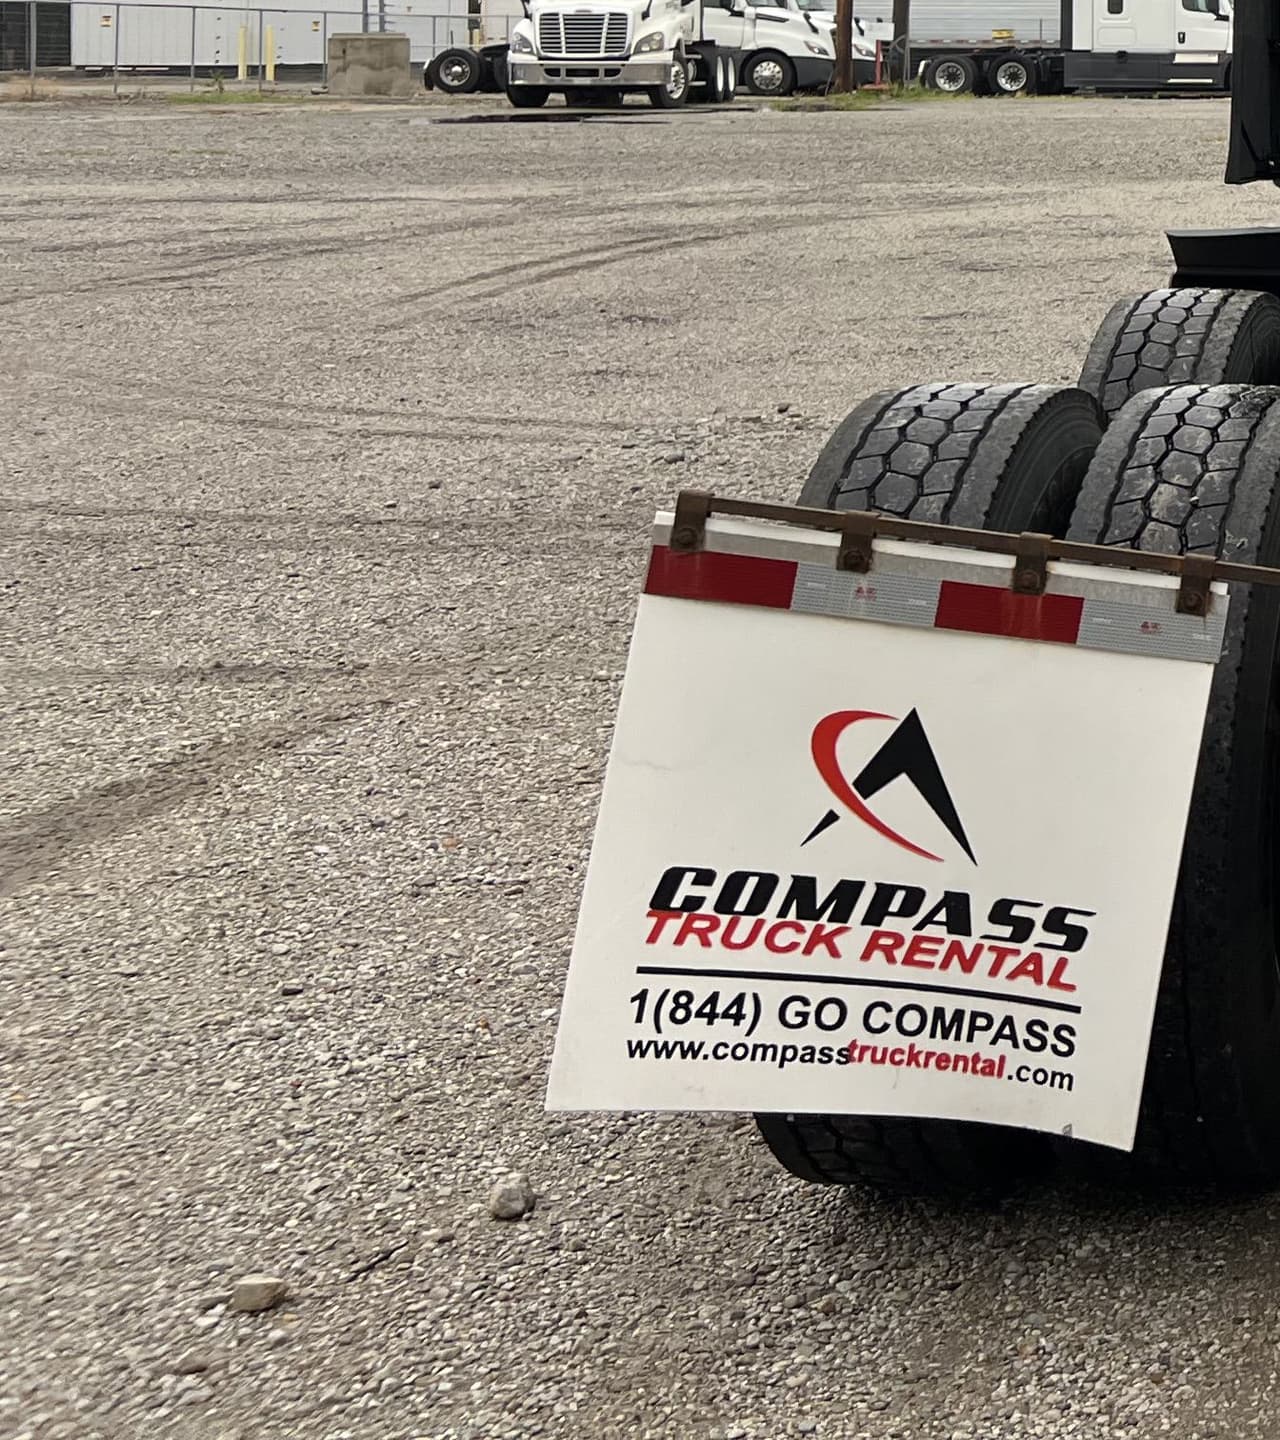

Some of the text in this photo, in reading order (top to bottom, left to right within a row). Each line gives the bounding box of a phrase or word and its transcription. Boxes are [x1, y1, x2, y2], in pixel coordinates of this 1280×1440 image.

[649, 866, 1096, 952] COMPASS
[645, 910, 1077, 991] TRUCK RENTAL
[630, 988, 1077, 1058] 1(844) GO COMPASS
[627, 1037, 1074, 1091] www.compasstruckrental.com
